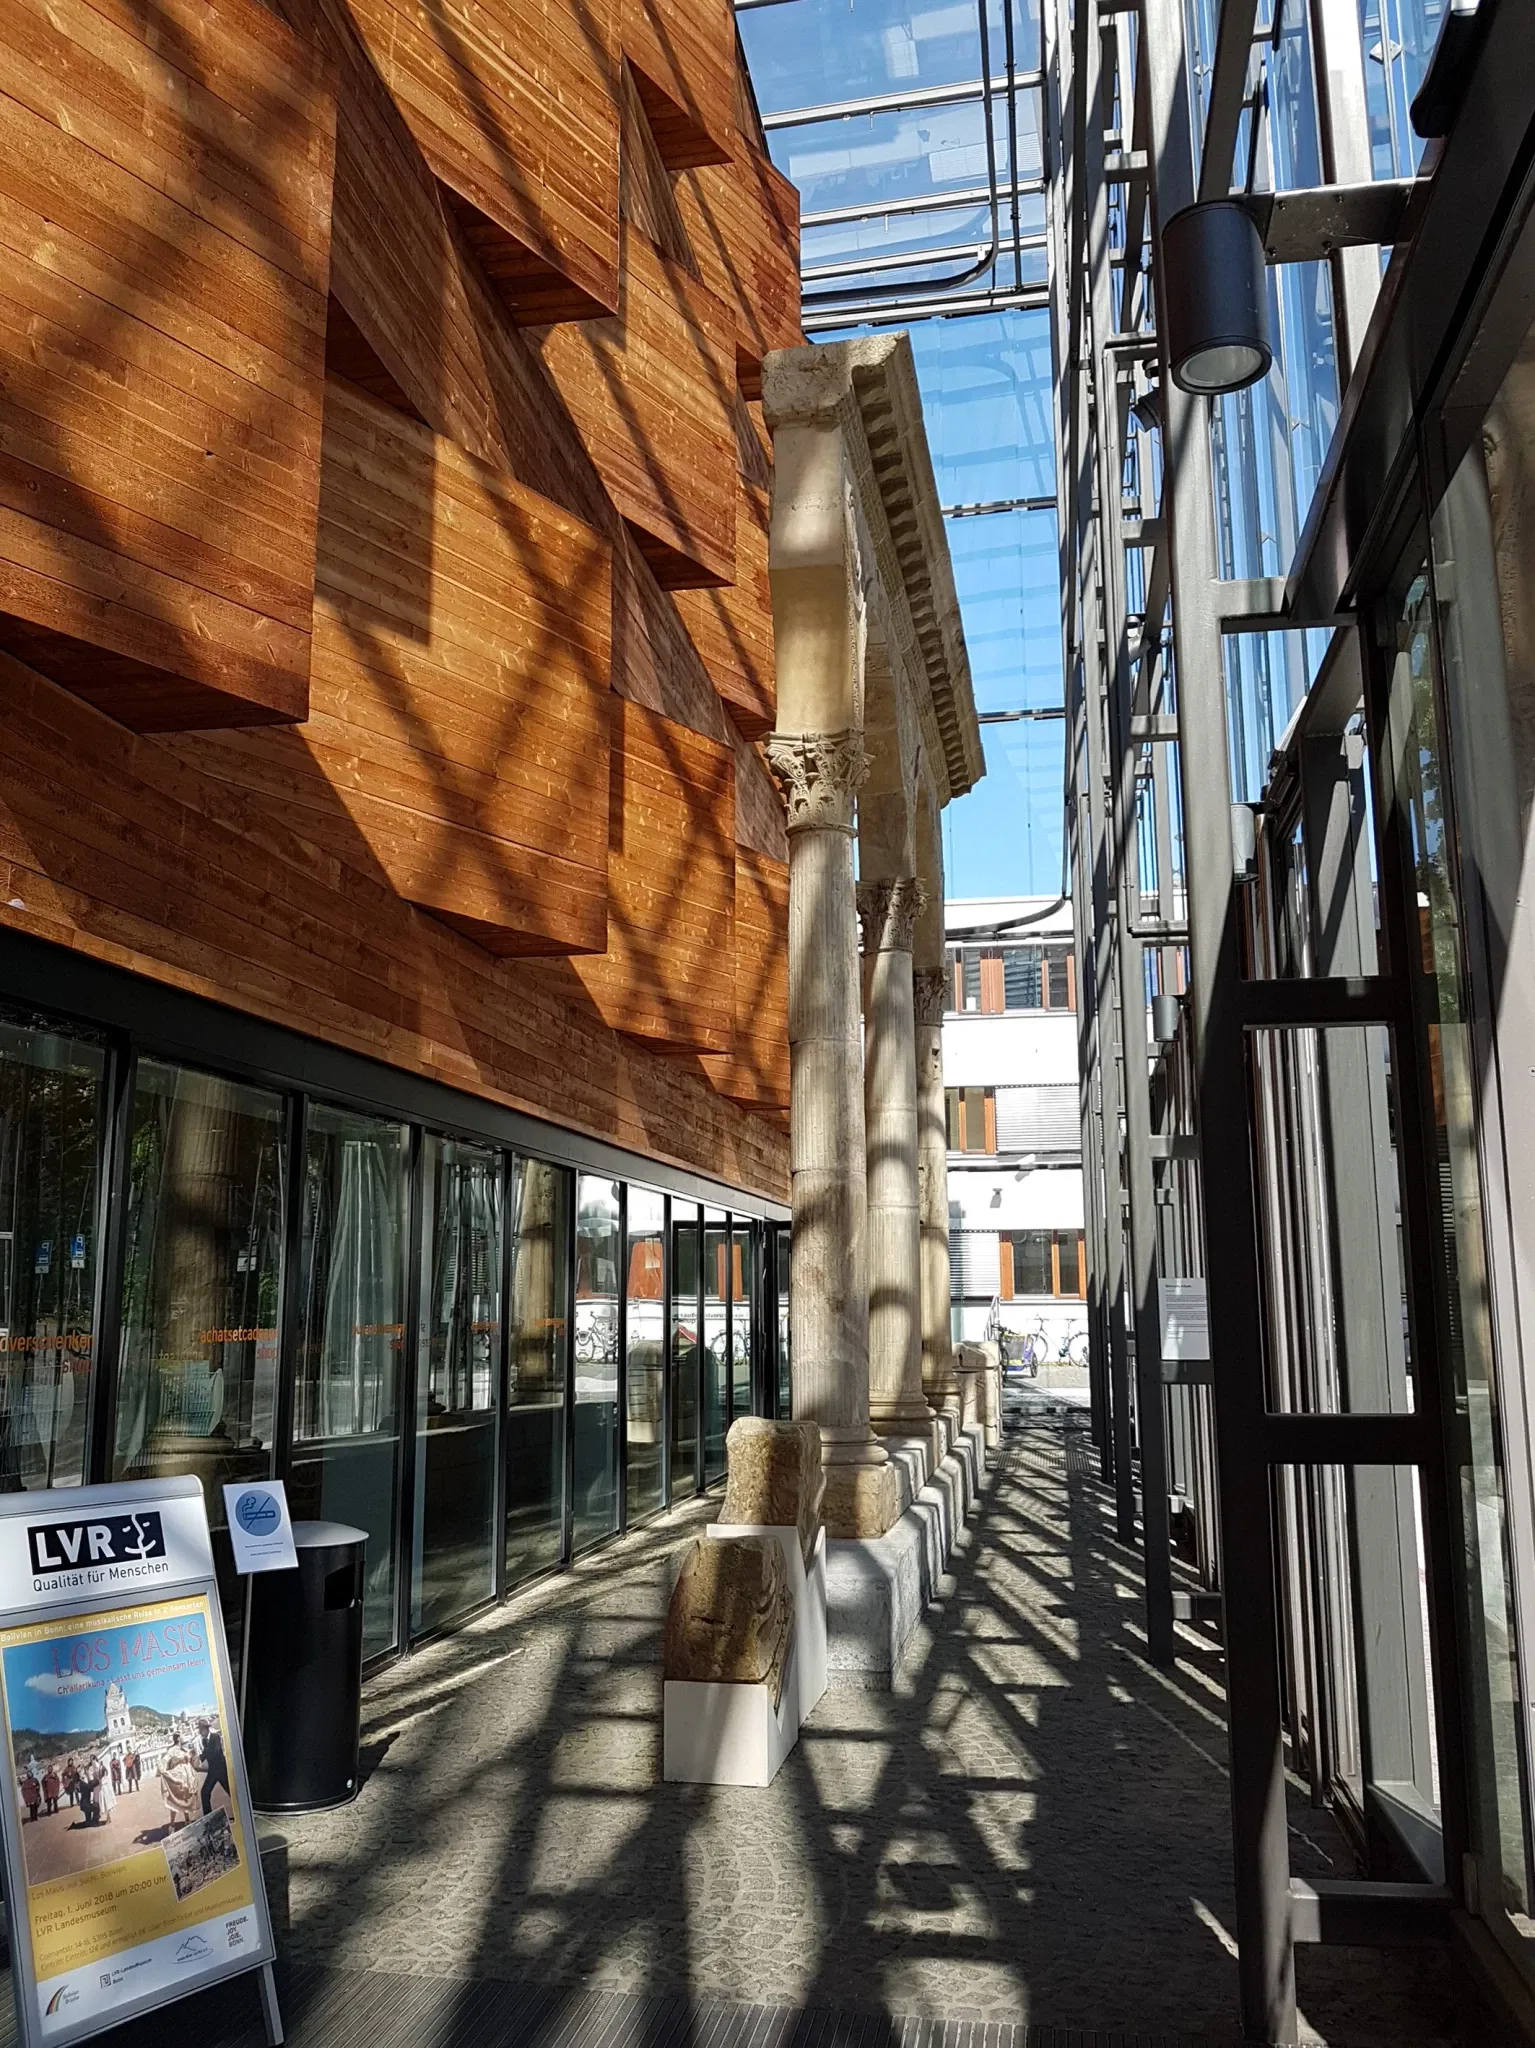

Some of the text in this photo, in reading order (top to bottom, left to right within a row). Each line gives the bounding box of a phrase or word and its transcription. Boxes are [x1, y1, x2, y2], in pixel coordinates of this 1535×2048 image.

[35, 1524, 116, 1568] LVR
[33, 1562, 169, 1592] Qualität für Menschen
[0, 1631, 32, 1643] Bolivien
[34, 1629, 42, 1637] in
[67, 1622, 84, 1632] eine
[86, 1613, 132, 1628] musikalische
[133, 1610, 153, 1619] Reise
[52, 1621, 204, 1679] LOS MASIS
[131, 1671, 145, 1680] uns
[146, 1663, 187, 1678] gemeinsam
[34, 1909, 66, 1926] Freitag,
[75, 1899, 93, 1912] Juni
[94, 1892, 114, 1906] 2018
[115, 1889, 128, 1899] um
[130, 1881, 153, 1893] 20:00
[154, 1874, 168, 1886] Uhr
[36, 1904, 118, 1938] LVR Landesmuseum
